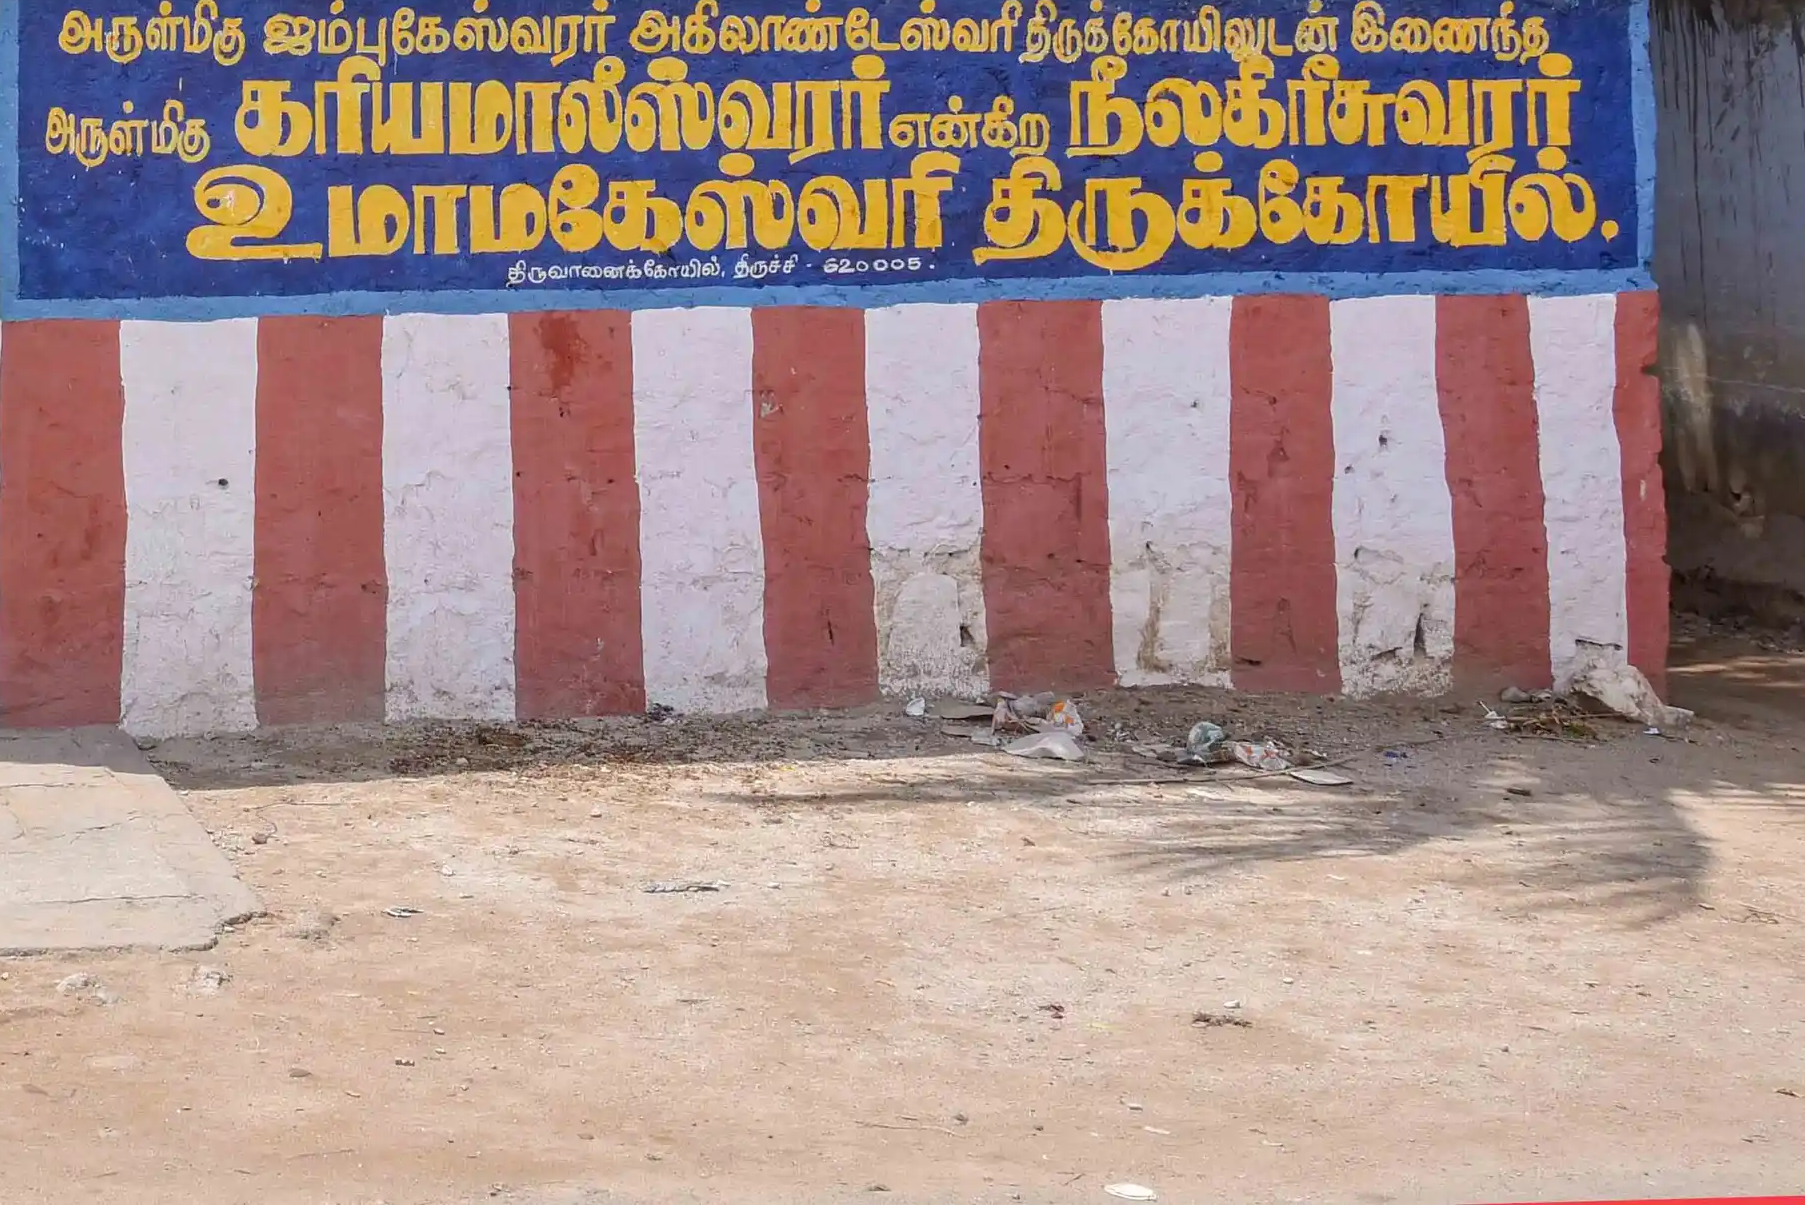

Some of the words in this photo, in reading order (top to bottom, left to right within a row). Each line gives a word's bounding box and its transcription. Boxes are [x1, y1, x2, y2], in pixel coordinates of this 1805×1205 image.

[1350, 0, 1550, 66] இணைந்த
[45, 99, 211, 169] அருள்மிகு
[732, 253, 799, 280] திருச்சி
